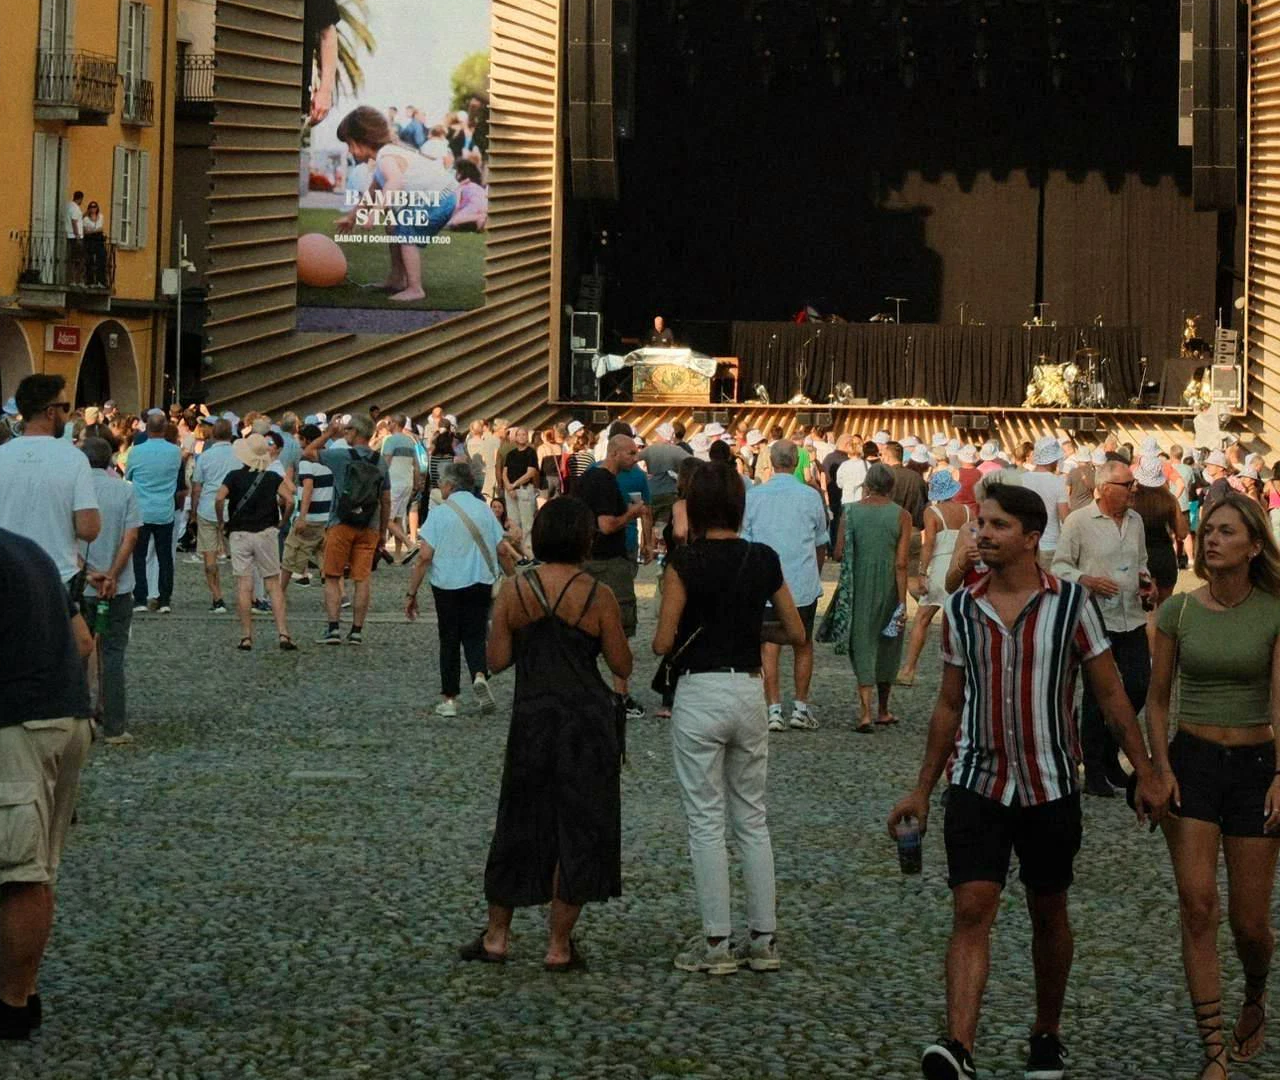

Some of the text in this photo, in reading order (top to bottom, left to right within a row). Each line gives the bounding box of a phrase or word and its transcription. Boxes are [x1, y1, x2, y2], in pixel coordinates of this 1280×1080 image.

[344, 189, 441, 207] BAMBINI
[355, 208, 430, 226] STAGE
[334, 234, 362, 243] SABATO
[363, 235, 368, 243] E
[369, 235, 407, 243] DOMENICA
[432, 236, 451, 244] 17:00
